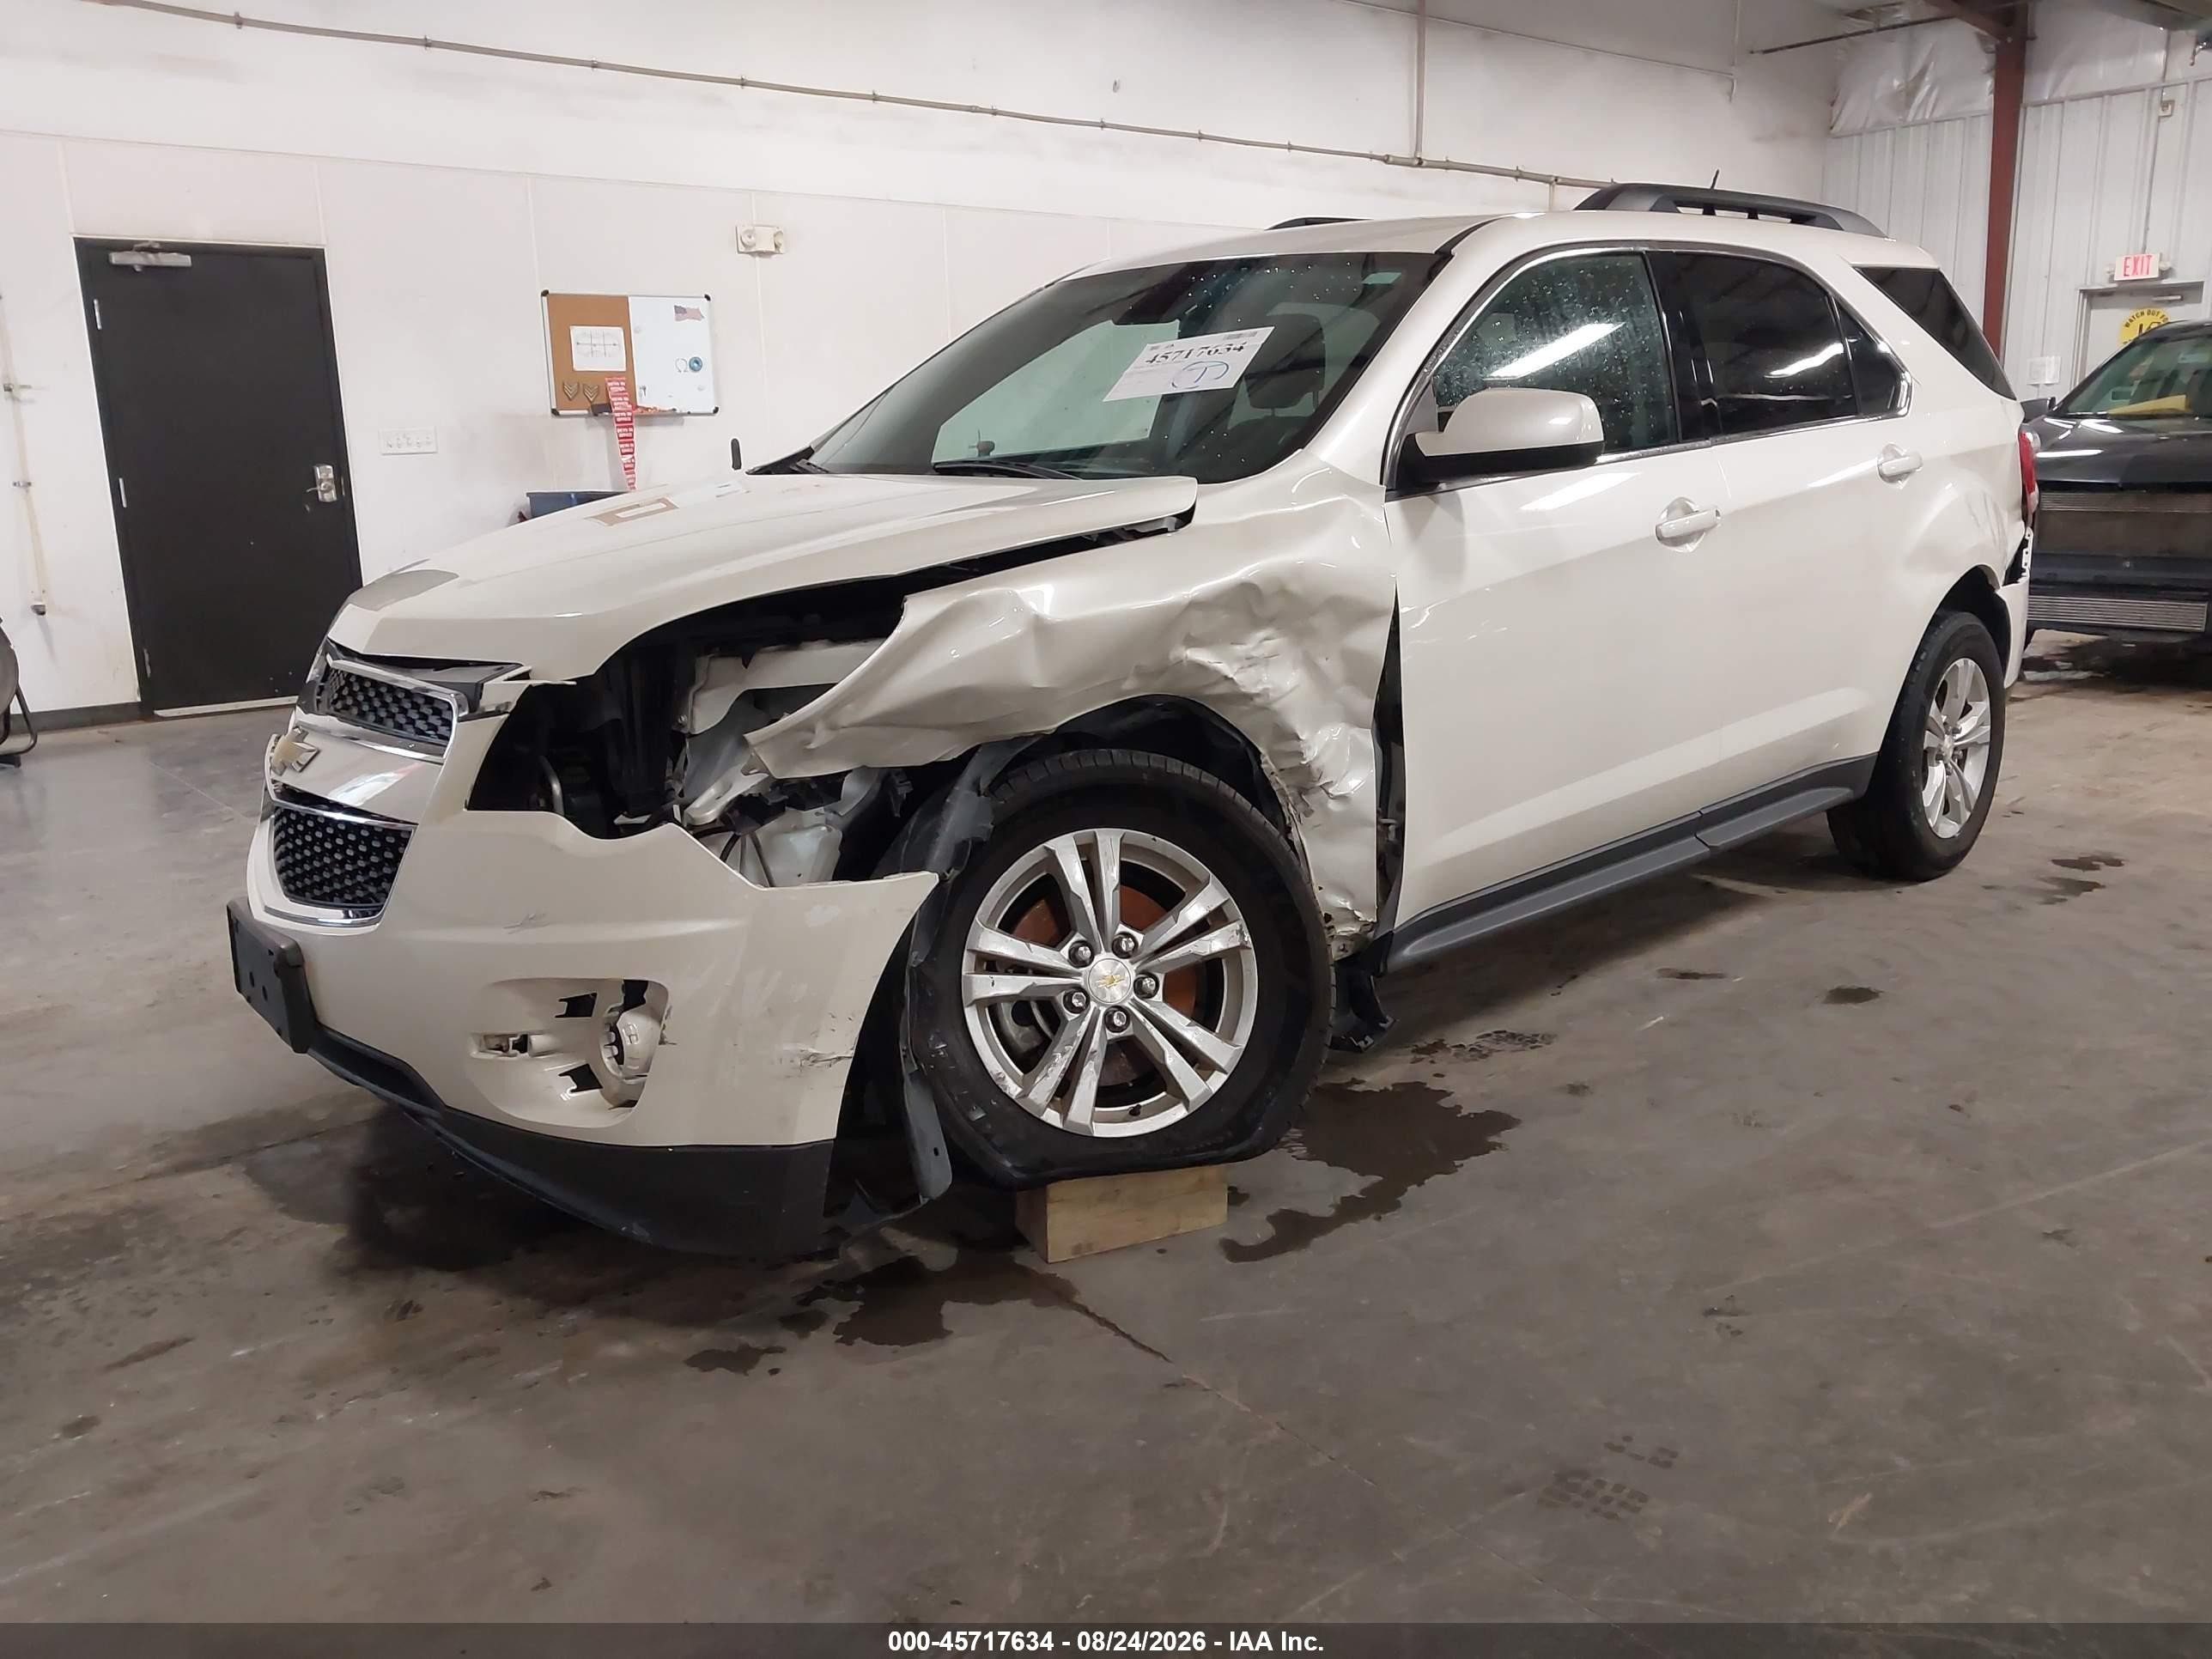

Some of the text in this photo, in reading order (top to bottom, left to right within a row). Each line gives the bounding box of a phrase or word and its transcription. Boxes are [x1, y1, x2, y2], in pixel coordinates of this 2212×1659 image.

[2124, 255, 2153, 276] EXIT
[2125, 311, 2145, 327] WATCH
[1146, 342, 1248, 364] 45717634
